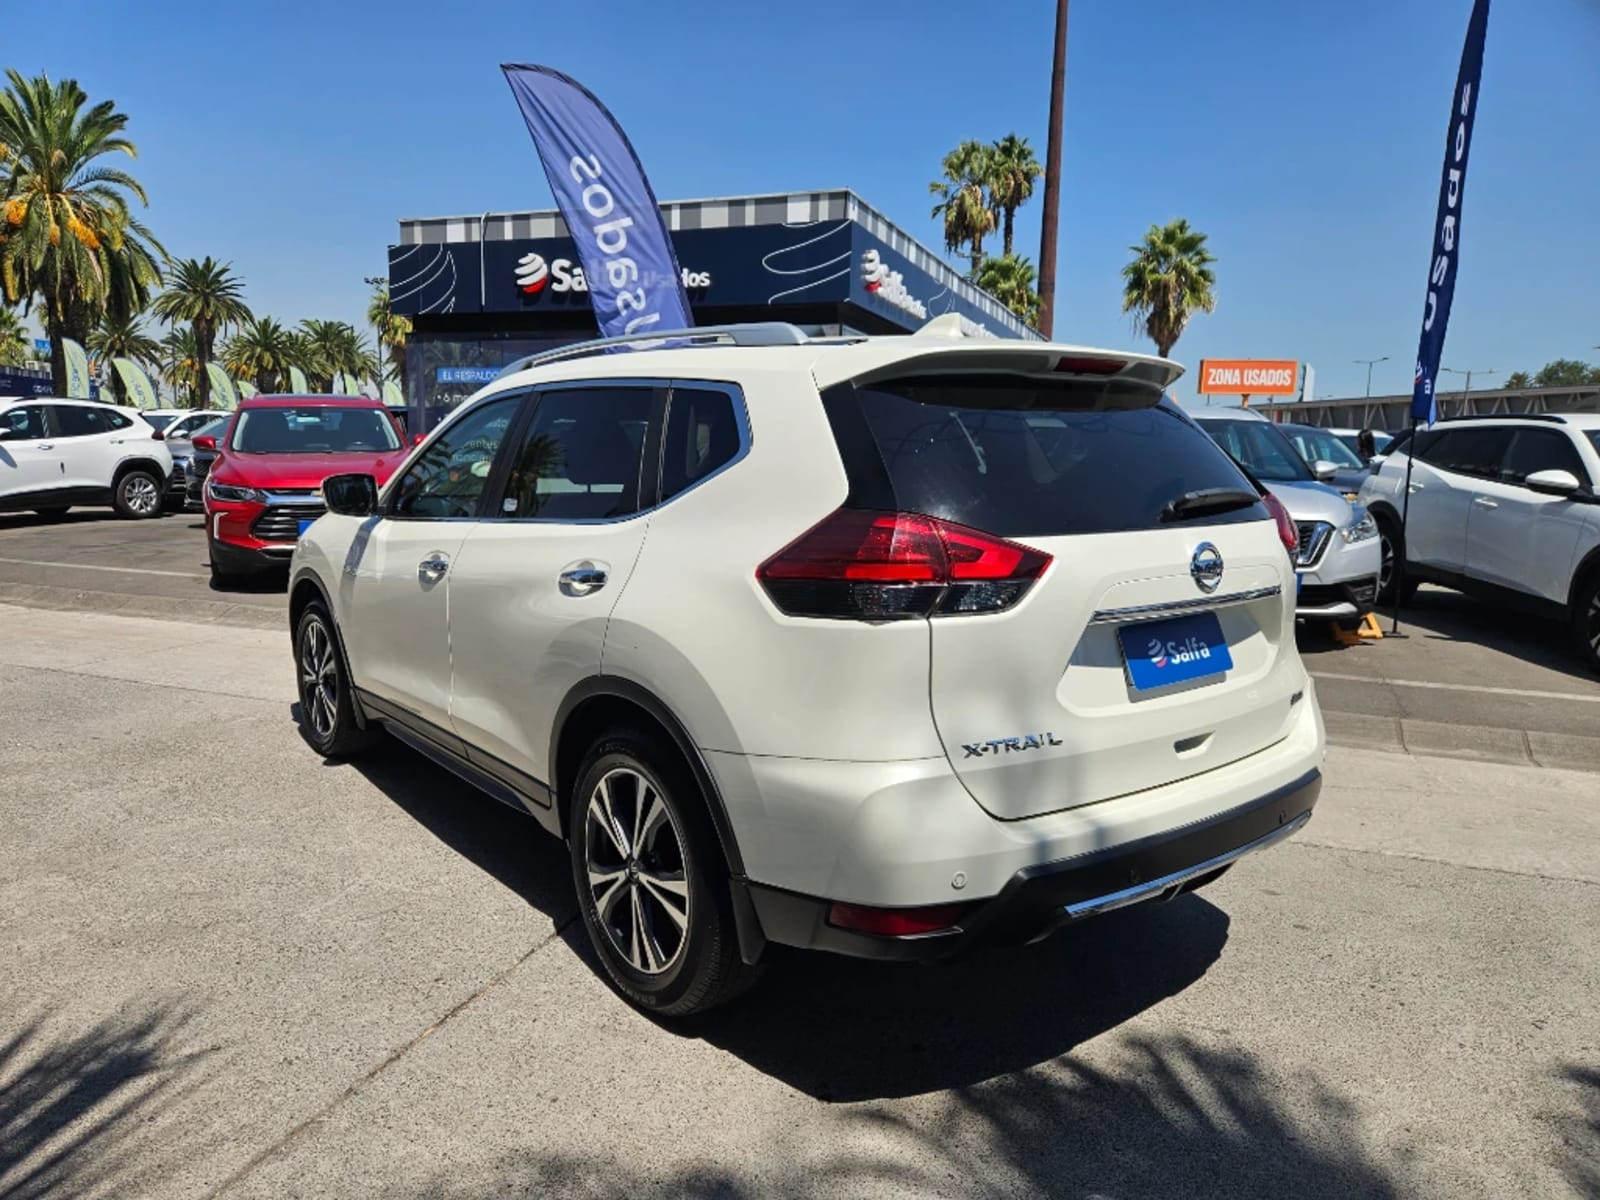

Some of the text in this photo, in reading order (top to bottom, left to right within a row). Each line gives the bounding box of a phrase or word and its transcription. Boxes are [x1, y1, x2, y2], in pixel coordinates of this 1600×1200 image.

[1424, 82, 1472, 332] Usados
[1208, 367, 1292, 387] ZONA USADOS
[1166, 637, 1211, 665] Salfa
[960, 732, 1063, 759] X-TRAIL
